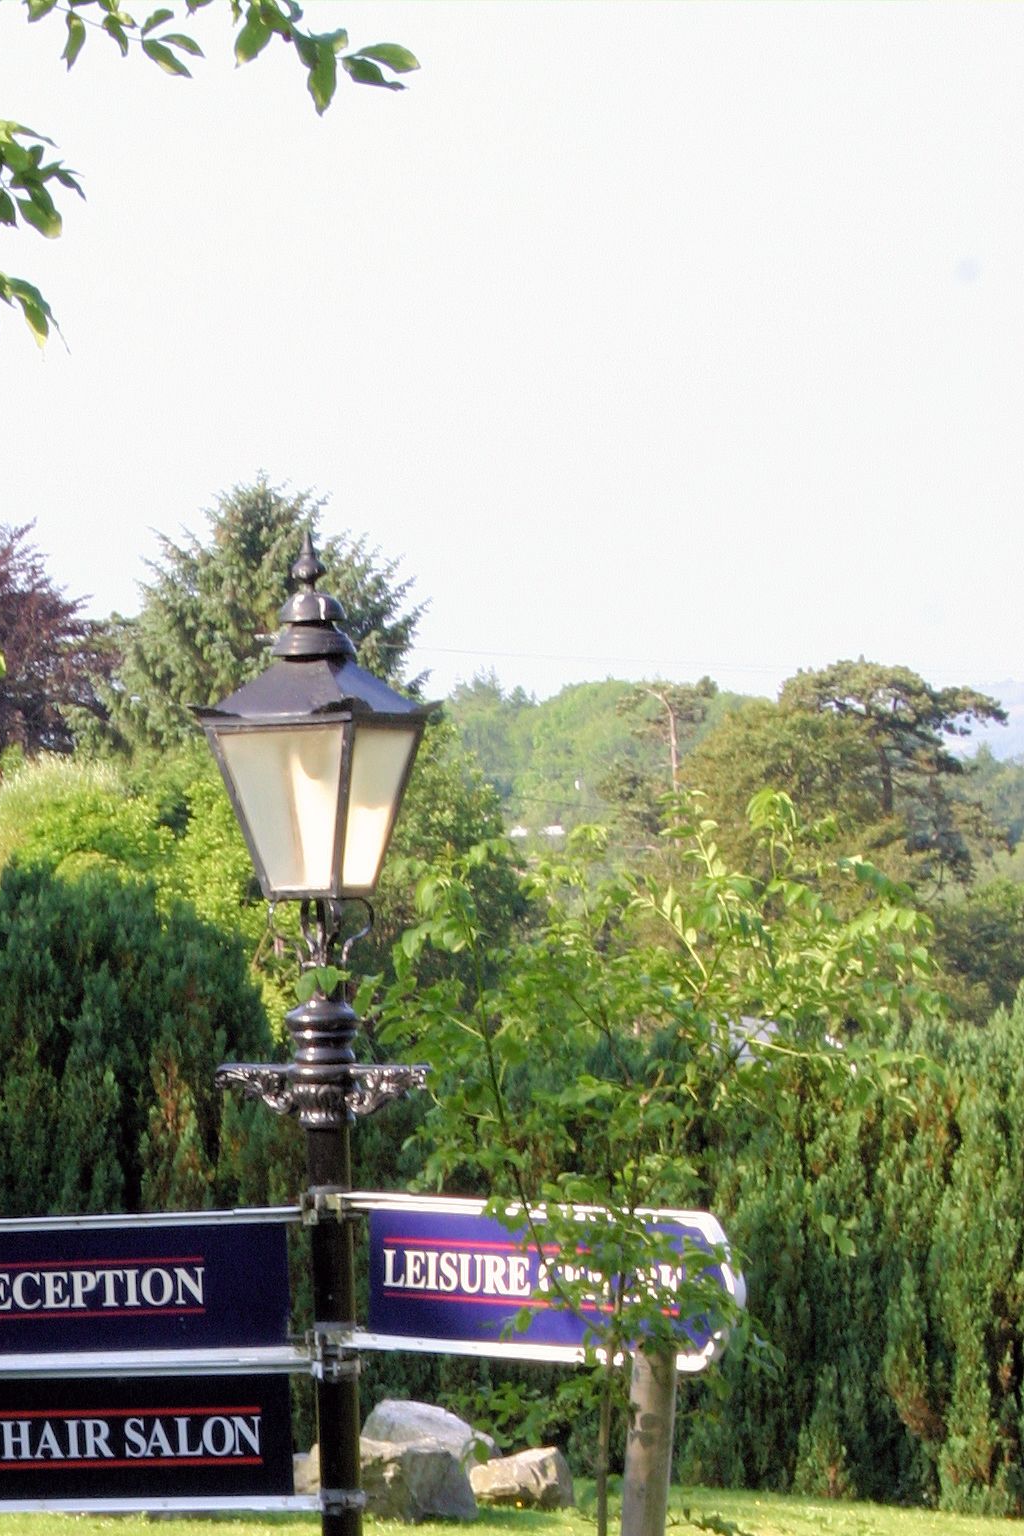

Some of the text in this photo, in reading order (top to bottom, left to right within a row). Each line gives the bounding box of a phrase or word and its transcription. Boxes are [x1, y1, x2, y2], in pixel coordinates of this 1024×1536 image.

[383, 1249, 531, 1296] LEISURE
[0, 1419, 115, 1460] HAIR
[124, 1416, 261, 1458] SALON
